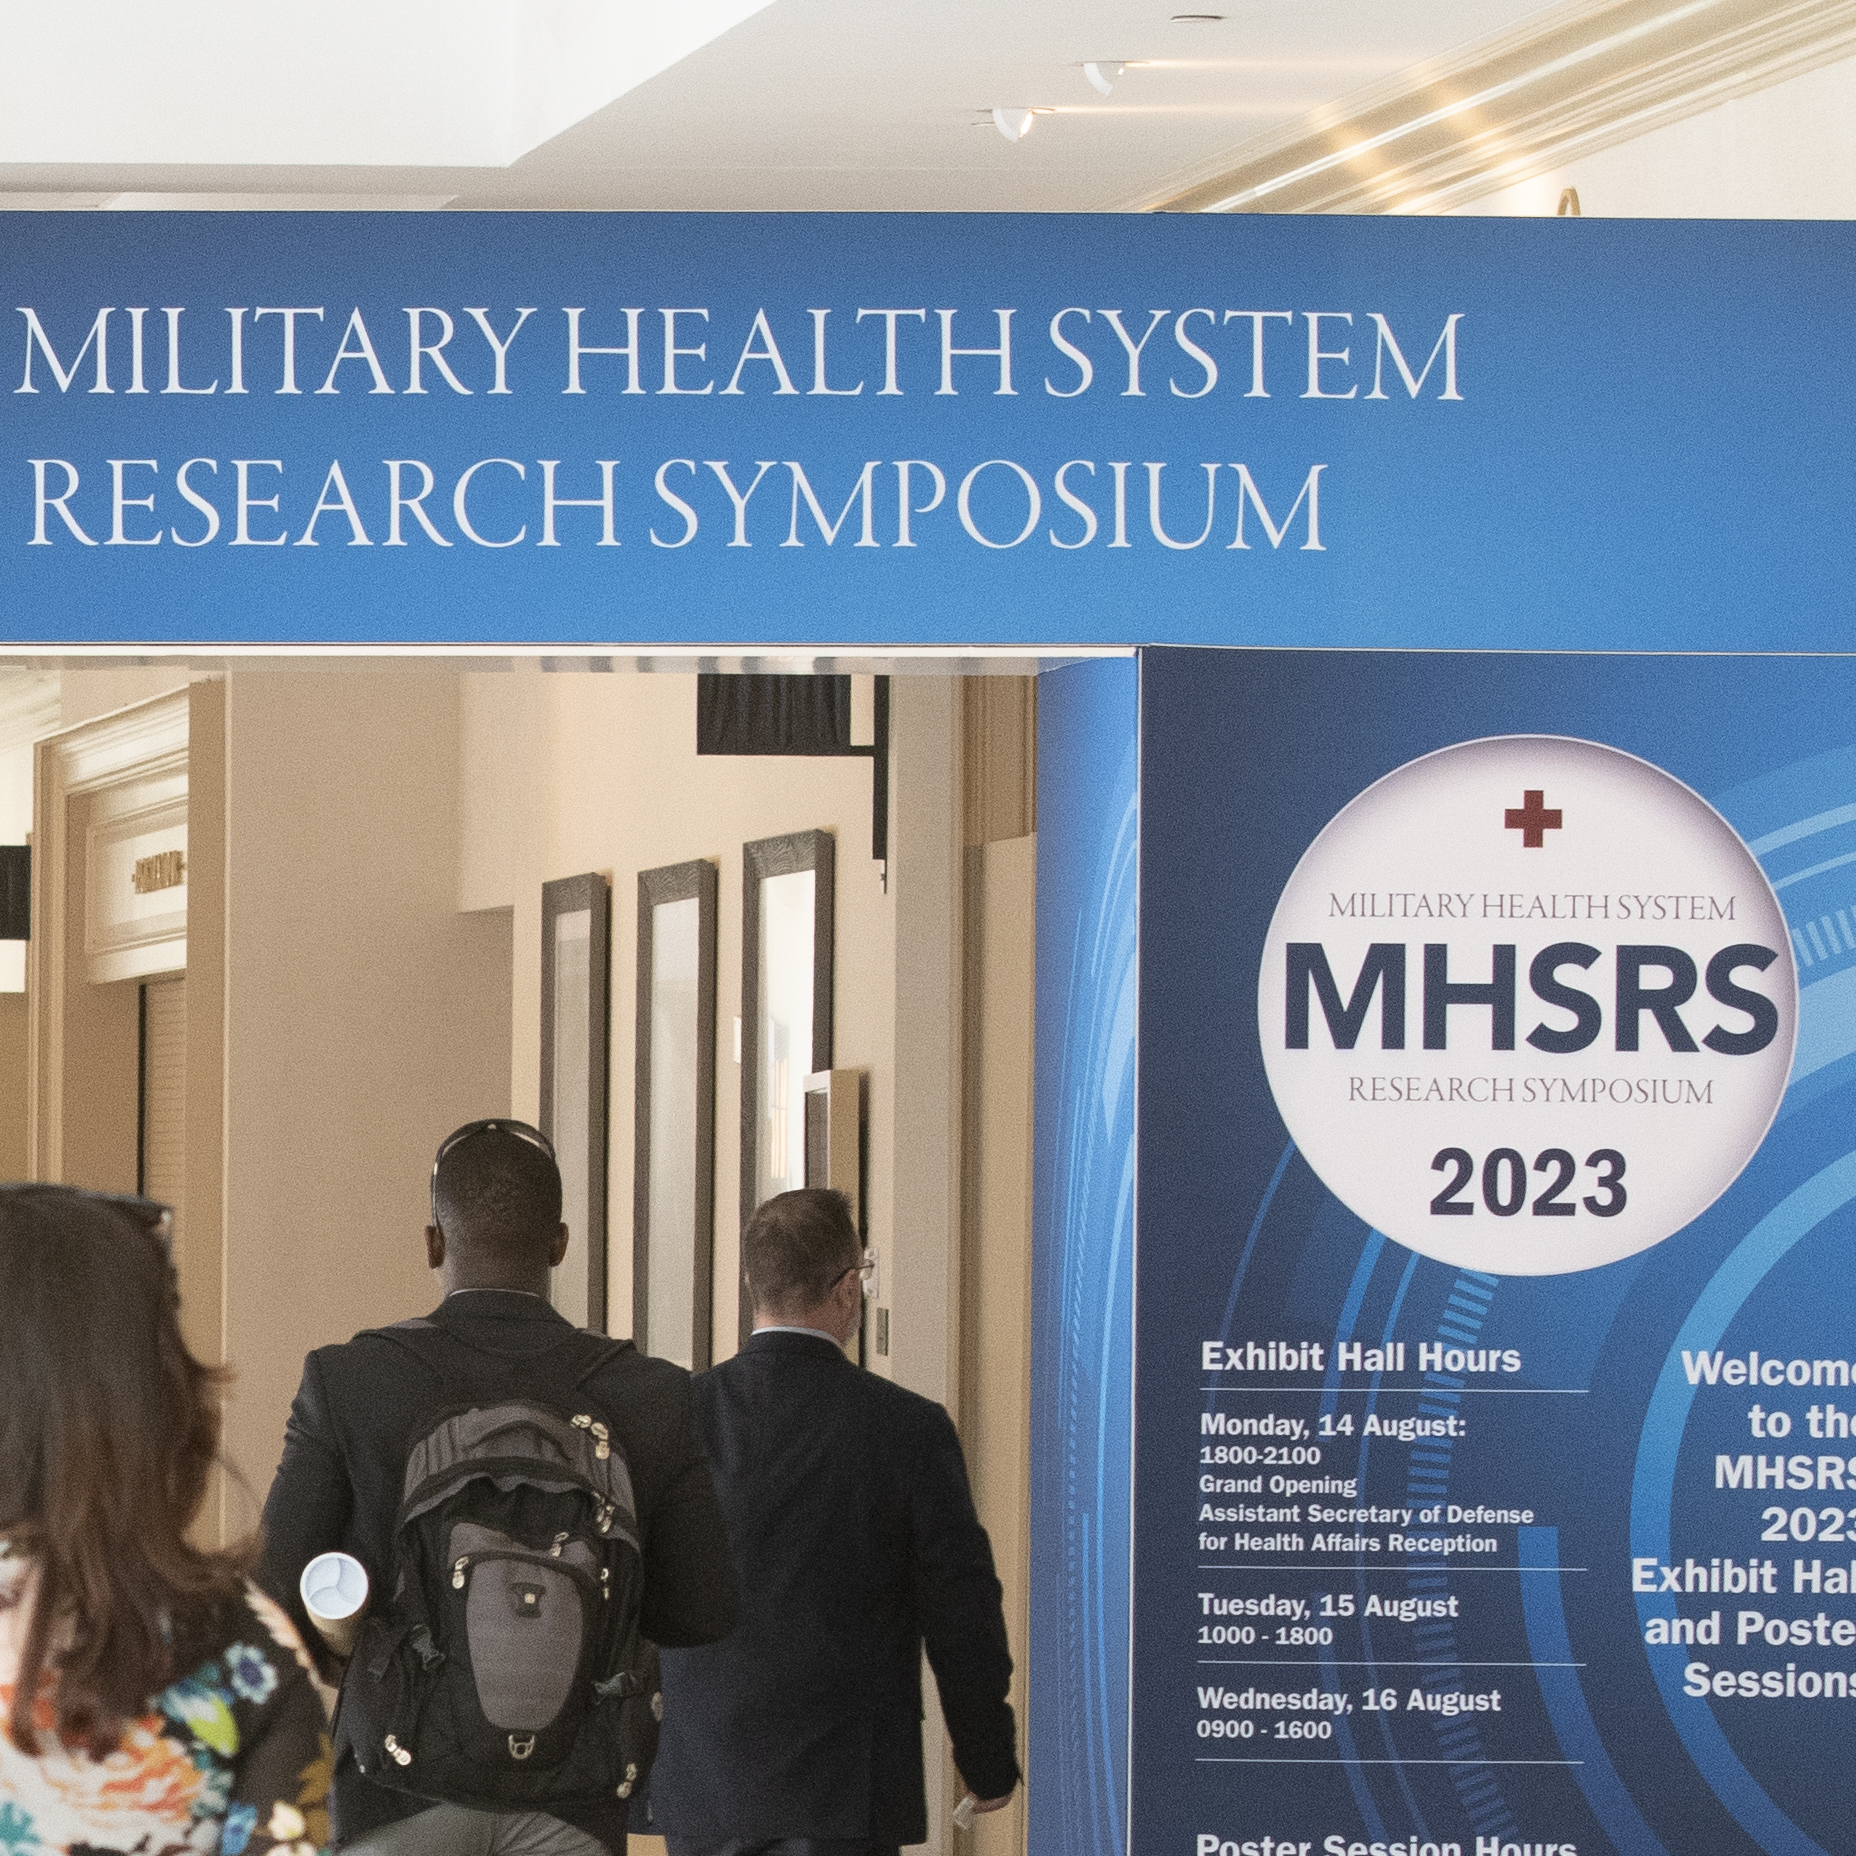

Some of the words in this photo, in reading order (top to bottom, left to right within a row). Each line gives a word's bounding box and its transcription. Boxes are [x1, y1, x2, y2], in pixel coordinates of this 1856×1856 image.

[16, 306, 536, 396] MILITARY
[563, 307, 1017, 397] HEALTH
[1045, 307, 1464, 401] SYSTEM
[29, 457, 620, 548] RESEARCH
[650, 458, 1326, 551] SYMPOSIUM
[1329, 892, 1475, 918] MILITARY
[1482, 893, 1610, 920] HEALTH
[1618, 894, 1736, 921] SYSTEM
[1285, 941, 1780, 1056] MHSRS
[1349, 1076, 1514, 1102] RESEARCH
[1523, 1077, 1713, 1105] SYMPOSIUM
[1430, 1147, 1628, 1218] 2023
[1202, 1341, 1324, 1371] Exhibit
[1338, 1342, 1405, 1371] Hall
[1419, 1342, 1521, 1372] Hours
[1681, 1350, 1856, 1386] Welcom
[1201, 1412, 1310, 1441] Monday,
[1319, 1414, 1354, 1436] 14
[1363, 1414, 1466, 1442] August:
[1748, 1404, 1792, 1438] to
[1806, 1404, 1856, 1438] th
[1200, 1445, 1321, 1465] 1800-2100
[1199, 1474, 1262, 1493] Grand
[1269, 1475, 1358, 1498] Opening
[1199, 1503, 1301, 1523] Assistant
[1308, 1504, 1413, 1527] Secretary
[1419, 1505, 1441, 1523] of
[1447, 1505, 1534, 1524] Defense
[1199, 1532, 1228, 1550] for
[1234, 1532, 1304, 1551] Health
[1311, 1533, 1381, 1552] Affairs
[1388, 1533, 1498, 1556] Reception
[1632, 1557, 1777, 1594] Exhibit
[1794, 1559, 1856, 1594] Hal
[1198, 1592, 1311, 1621] Tuesday,
[1320, 1594, 1355, 1617] 15
[1364, 1594, 1459, 1622] August
[1198, 1626, 1256, 1645] 1000
[1275, 1626, 1333, 1645] 1800
[1645, 1611, 1720, 1645] and
[1737, 1611, 1856, 1646] Poste
[1197, 1687, 1353, 1715] Wednesday,
[1362, 1688, 1398, 1711] 16
[1406, 1688, 1501, 1716] August
[1196, 1719, 1254, 1738] 0900
[1275, 1720, 1332, 1739] 1600
